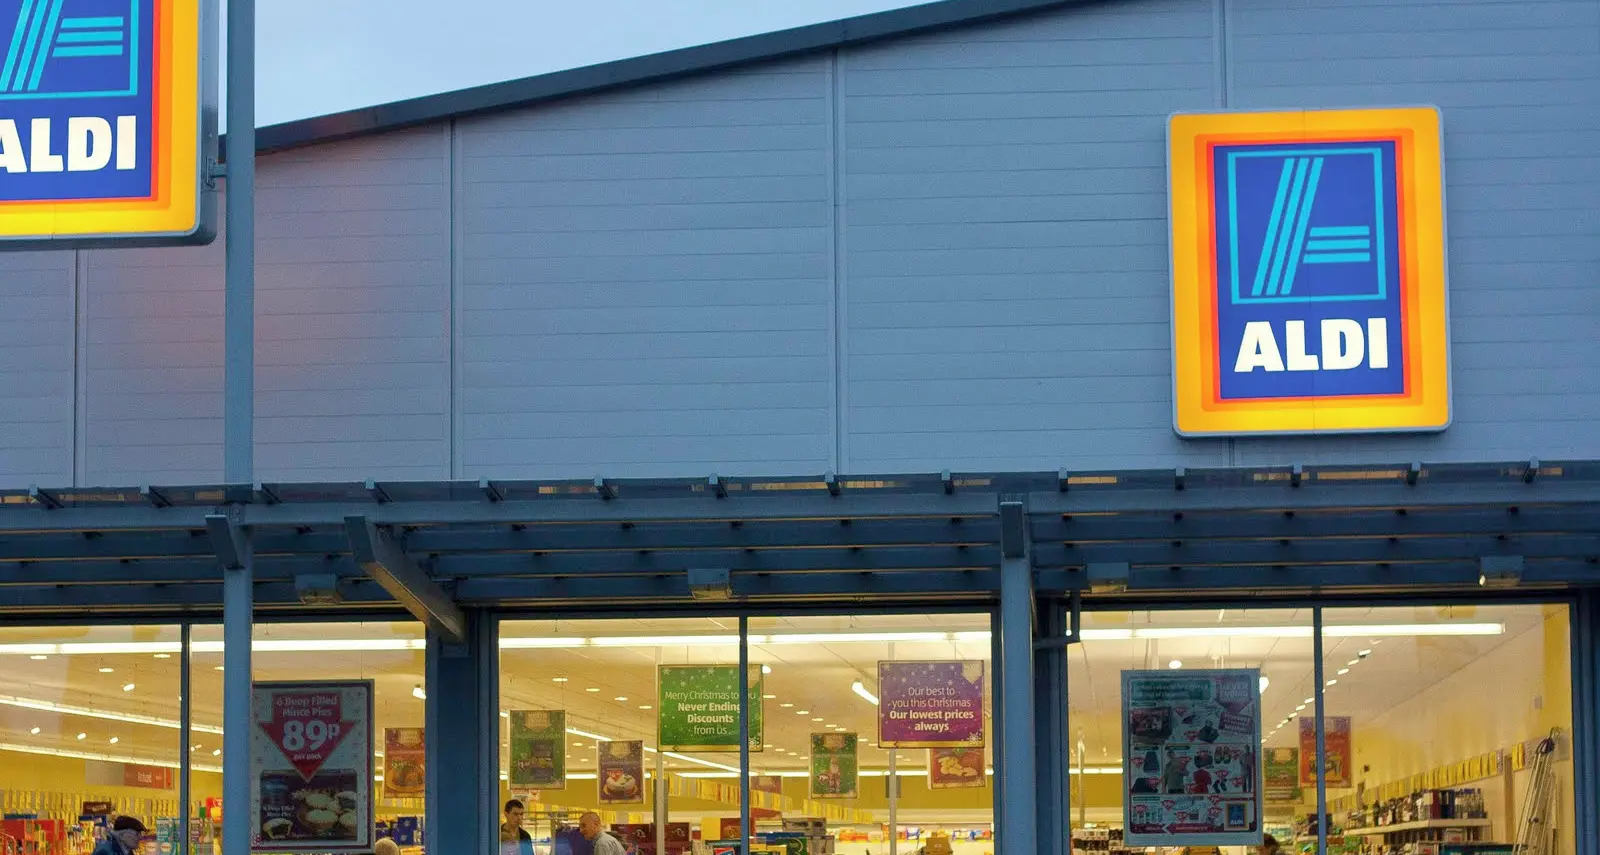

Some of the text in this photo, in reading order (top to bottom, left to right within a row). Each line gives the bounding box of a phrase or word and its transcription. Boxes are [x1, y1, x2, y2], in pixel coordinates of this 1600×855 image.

[1234, 317, 1388, 373] ALDI
[664, 691, 688, 701] Merry
[689, 690, 730, 700] Christmas
[731, 691, 739, 700] to
[908, 686, 955, 696] Our best to
[677, 702, 707, 711] Never
[892, 698, 971, 710] you this Christmas
[687, 713, 734, 723] Discounts
[889, 709, 974, 720] Our lowest prices
[693, 725, 715, 735] from
[914, 722, 950, 732] always
[282, 720, 340, 751] 89p
